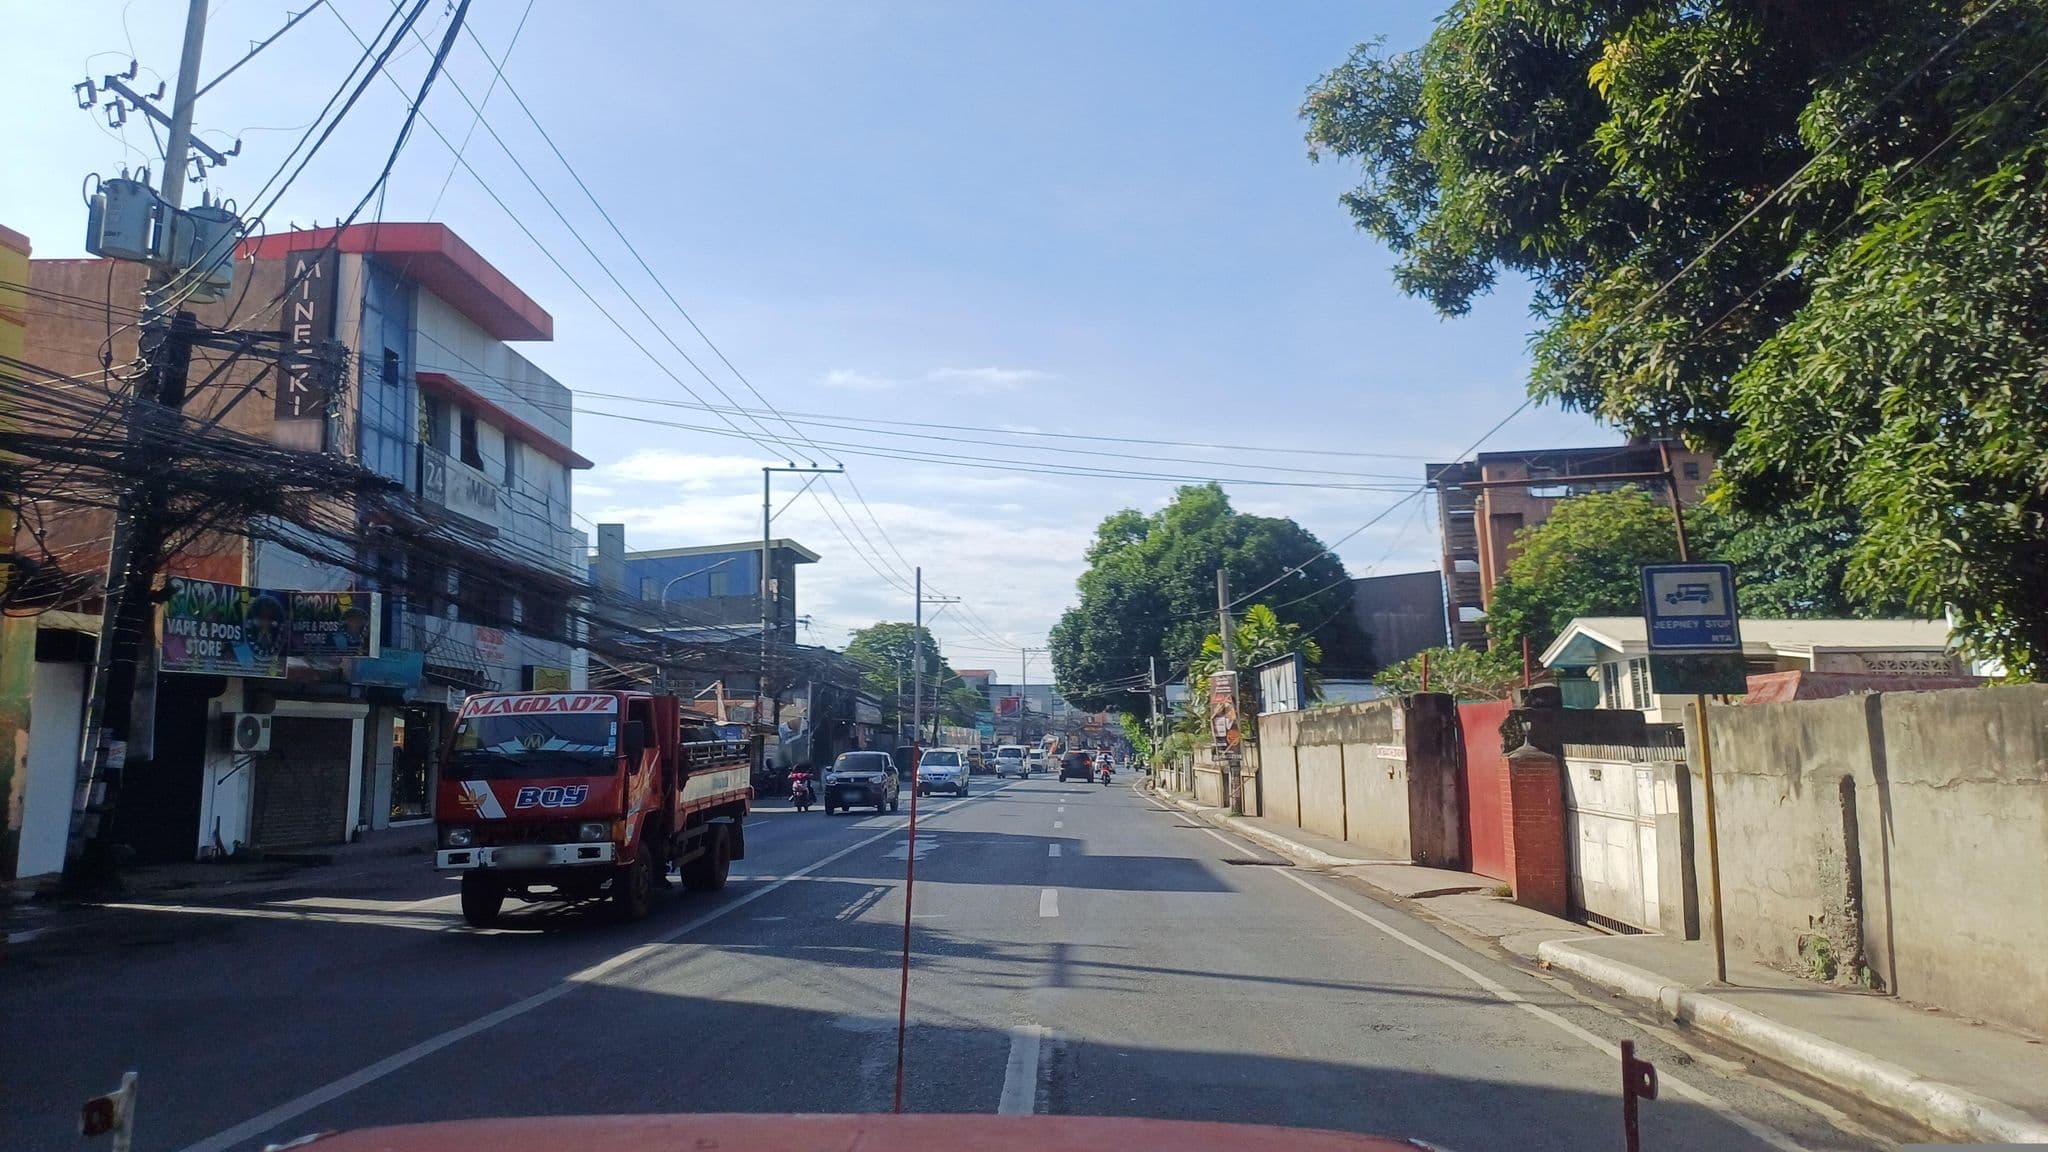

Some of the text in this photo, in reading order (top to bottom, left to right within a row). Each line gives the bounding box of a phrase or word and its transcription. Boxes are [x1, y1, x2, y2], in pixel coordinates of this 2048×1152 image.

[166, 618, 242, 640] VAPE & PODS
[1654, 619, 1732, 629] JEEPNEY STOP
[185, 638, 223, 657] STORE
[468, 696, 613, 716] MAGDAD'Z
[515, 785, 588, 808] BOY
